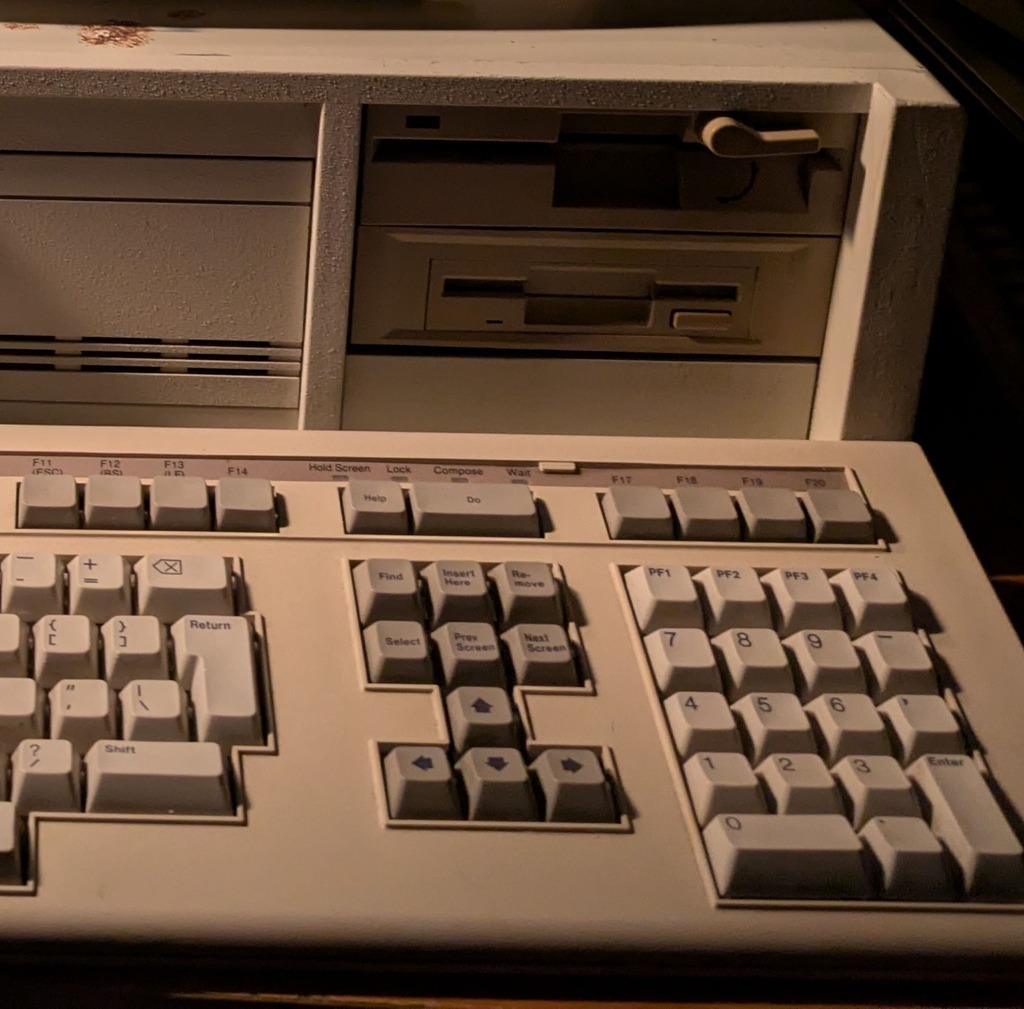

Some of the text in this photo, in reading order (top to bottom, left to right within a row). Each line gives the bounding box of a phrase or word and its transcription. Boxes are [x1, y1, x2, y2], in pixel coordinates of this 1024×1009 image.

[33, 458, 51, 466] F11
[100, 460, 120, 468] F12
[228, 467, 248, 475] F14
[335, 464, 370, 472] Screen
[434, 466, 483, 475] Compose
[612, 476, 826, 487] F17 F18 F19 F20
[364, 495, 387, 503] Help
[443, 569, 475, 577] Insert
[648, 568, 670, 577] PF1
[716, 570, 740, 578] PF2
[785, 571, 809, 580] PF3
[853, 572, 878, 581] PF4
[444, 578, 470, 586] Here
[190, 620, 230, 630] Return
[386, 637, 420, 645] Select
[524, 633, 549, 642] Next
[664, 632, 676, 646] 7
[736, 632, 752, 647] 8
[807, 634, 822, 648] 9
[456, 643, 495, 651] Screen
[527, 644, 566, 652] Screen
[685, 696, 698, 710] 4
[830, 697, 845, 712] 6
[105, 745, 136, 754] Shift
[853, 759, 871, 773] 3
[927, 757, 963, 766] Enter
